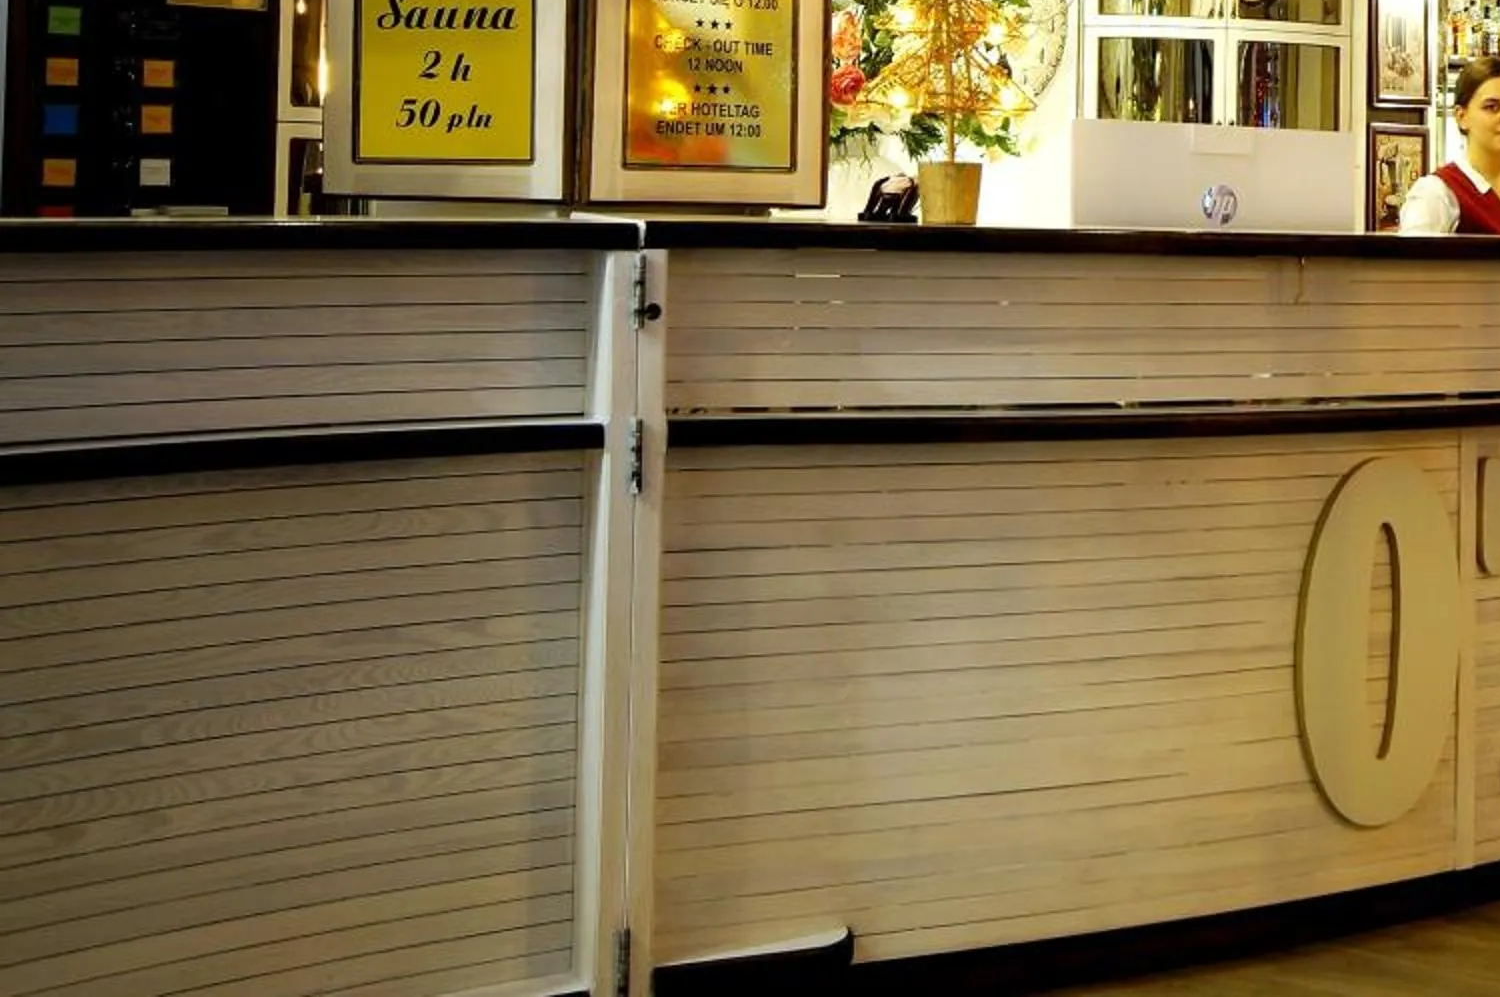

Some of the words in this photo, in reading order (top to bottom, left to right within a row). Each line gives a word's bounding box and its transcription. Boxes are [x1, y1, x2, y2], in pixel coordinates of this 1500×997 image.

[744, 41, 774, 57] TIME
[418, 49, 442, 80] 2
[450, 53, 473, 82] h
[687, 57, 700, 72] 12
[705, 58, 743, 74] NOON
[395, 98, 441, 129] 50
[446, 104, 493, 134] pln
[660, 101, 687, 116] ER
[691, 101, 761, 119] HOTELTAG
[655, 119, 701, 136] ENDET
[705, 121, 726, 137] UM
[730, 122, 762, 139] 12:00
